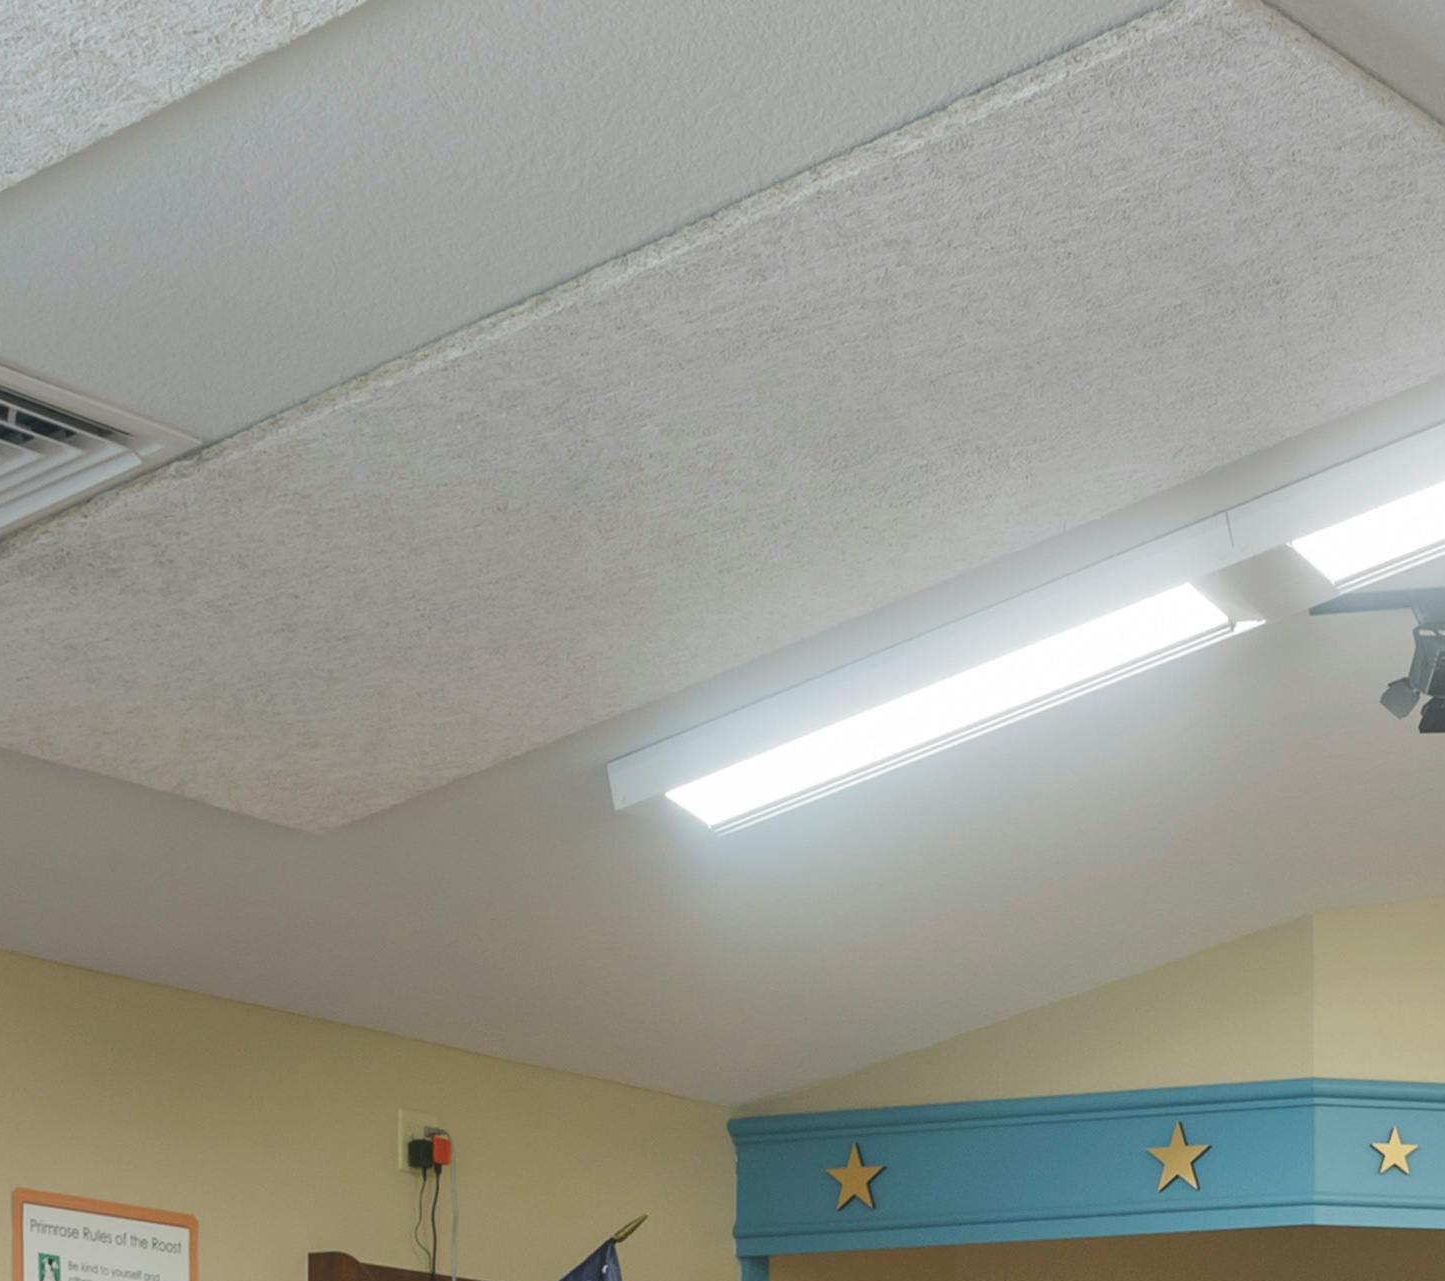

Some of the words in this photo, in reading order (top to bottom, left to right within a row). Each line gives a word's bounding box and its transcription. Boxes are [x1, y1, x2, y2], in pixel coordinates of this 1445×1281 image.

[30, 1218, 80, 1240] Primrose
[82, 1226, 113, 1246] Rules
[114, 1231, 128, 1247] of
[129, 1234, 149, 1250] the
[151, 1237, 182, 1254] Roost
[68, 1260, 79, 1272] Be
[80, 1261, 99, 1275] kind
[100, 1266, 110, 1277] to
[111, 1268, 143, 1281] yourself
